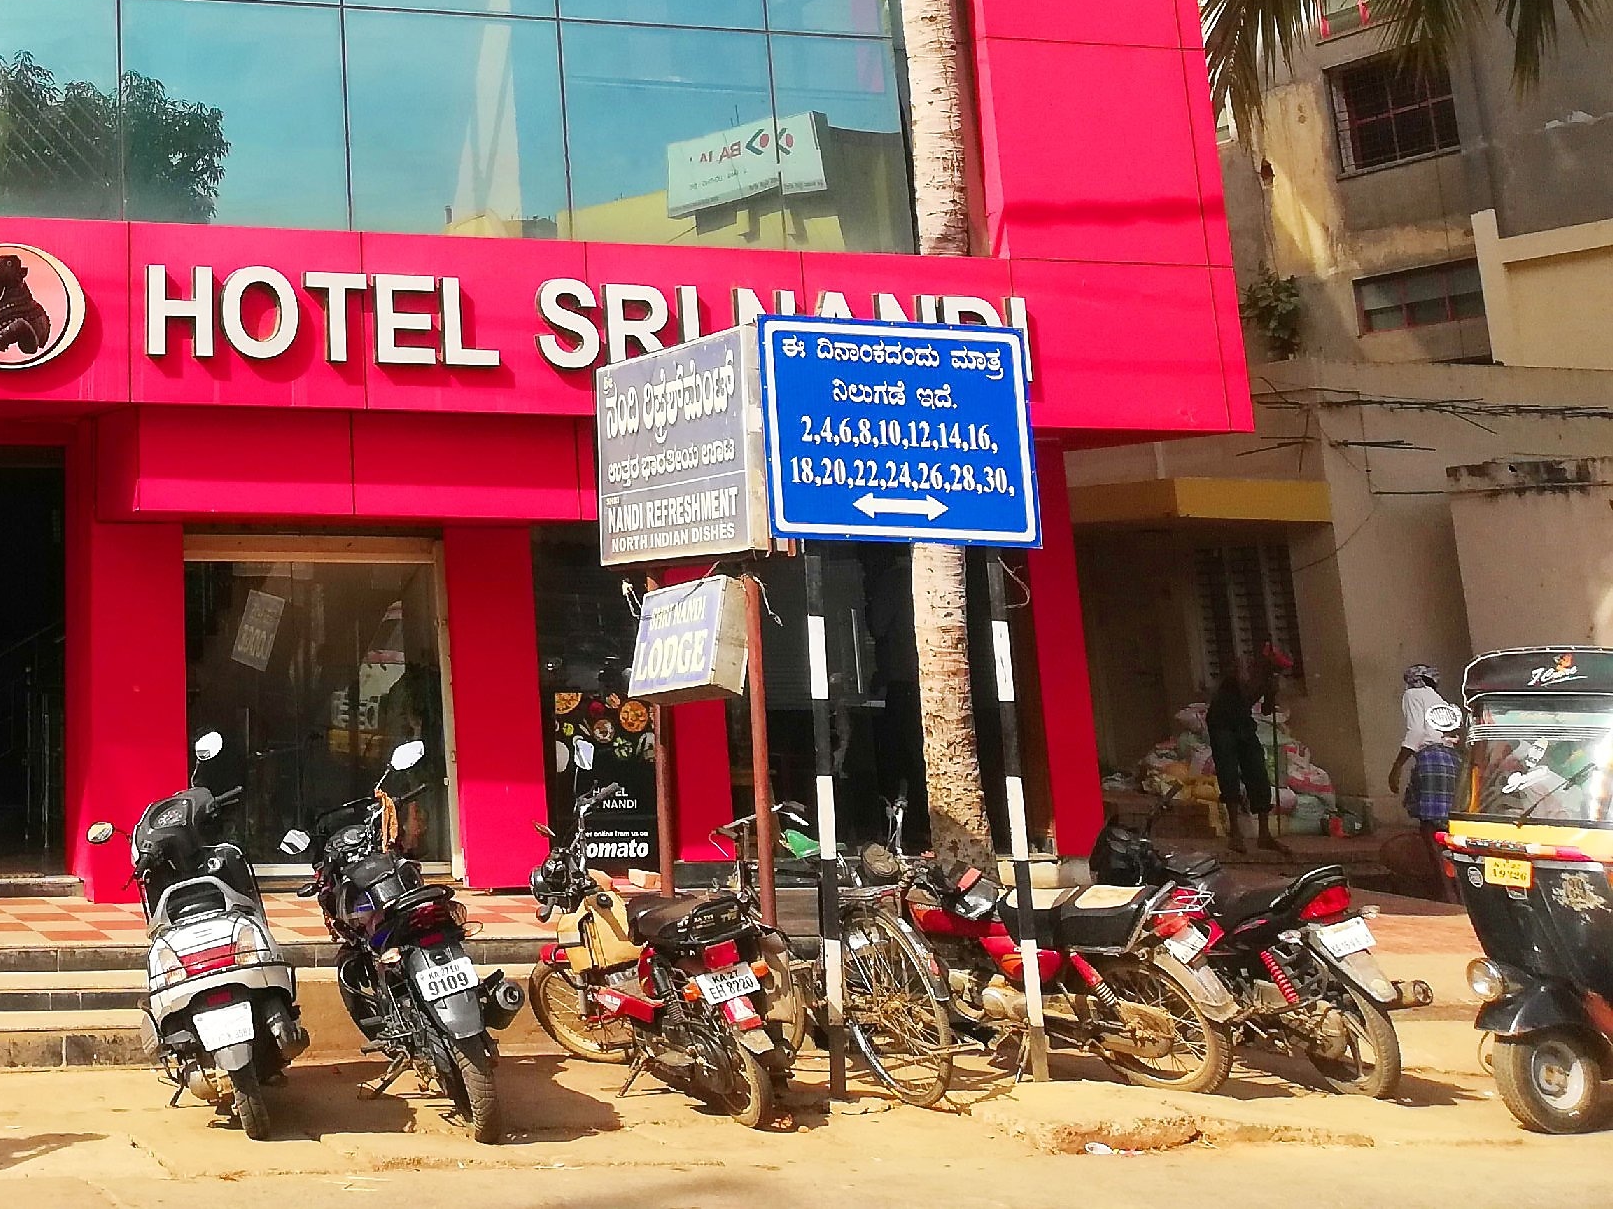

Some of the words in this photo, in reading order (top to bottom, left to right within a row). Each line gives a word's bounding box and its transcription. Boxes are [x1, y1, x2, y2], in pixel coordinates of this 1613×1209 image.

[144, 263, 501, 368] HOTEL
[536, 276, 700, 371] SRI
[781, 334, 807, 358] ಈ
[816, 337, 941, 368] ದಿನಾಂಕದಂದು
[949, 345, 1005, 381] ಮಾತ್ರ
[831, 378, 907, 406] ನಿಲುಗಡೆ
[605, 382, 640, 439] ನಂದಿ
[800, 414, 999, 455] 2,4,6,8,10,12,14,16,
[608, 455, 639, 487] ಉತ್ತರ
[790, 456, 1016, 497] 18,20,22,24,26,28,30,
[608, 502, 643, 534] NANDI
[646, 486, 738, 529] REFRESHMENT
[611, 534, 648, 553] NORTH
[650, 528, 689, 550] INDIAN
[691, 522, 735, 544] DISHES
[674, 595, 707, 625] NANDI
[634, 629, 709, 682] LODGE
[593, 786, 629, 797] HEL
[602, 798, 637, 809] NANDI
[585, 838, 649, 858] omato
[428, 971, 469, 996] 9109
